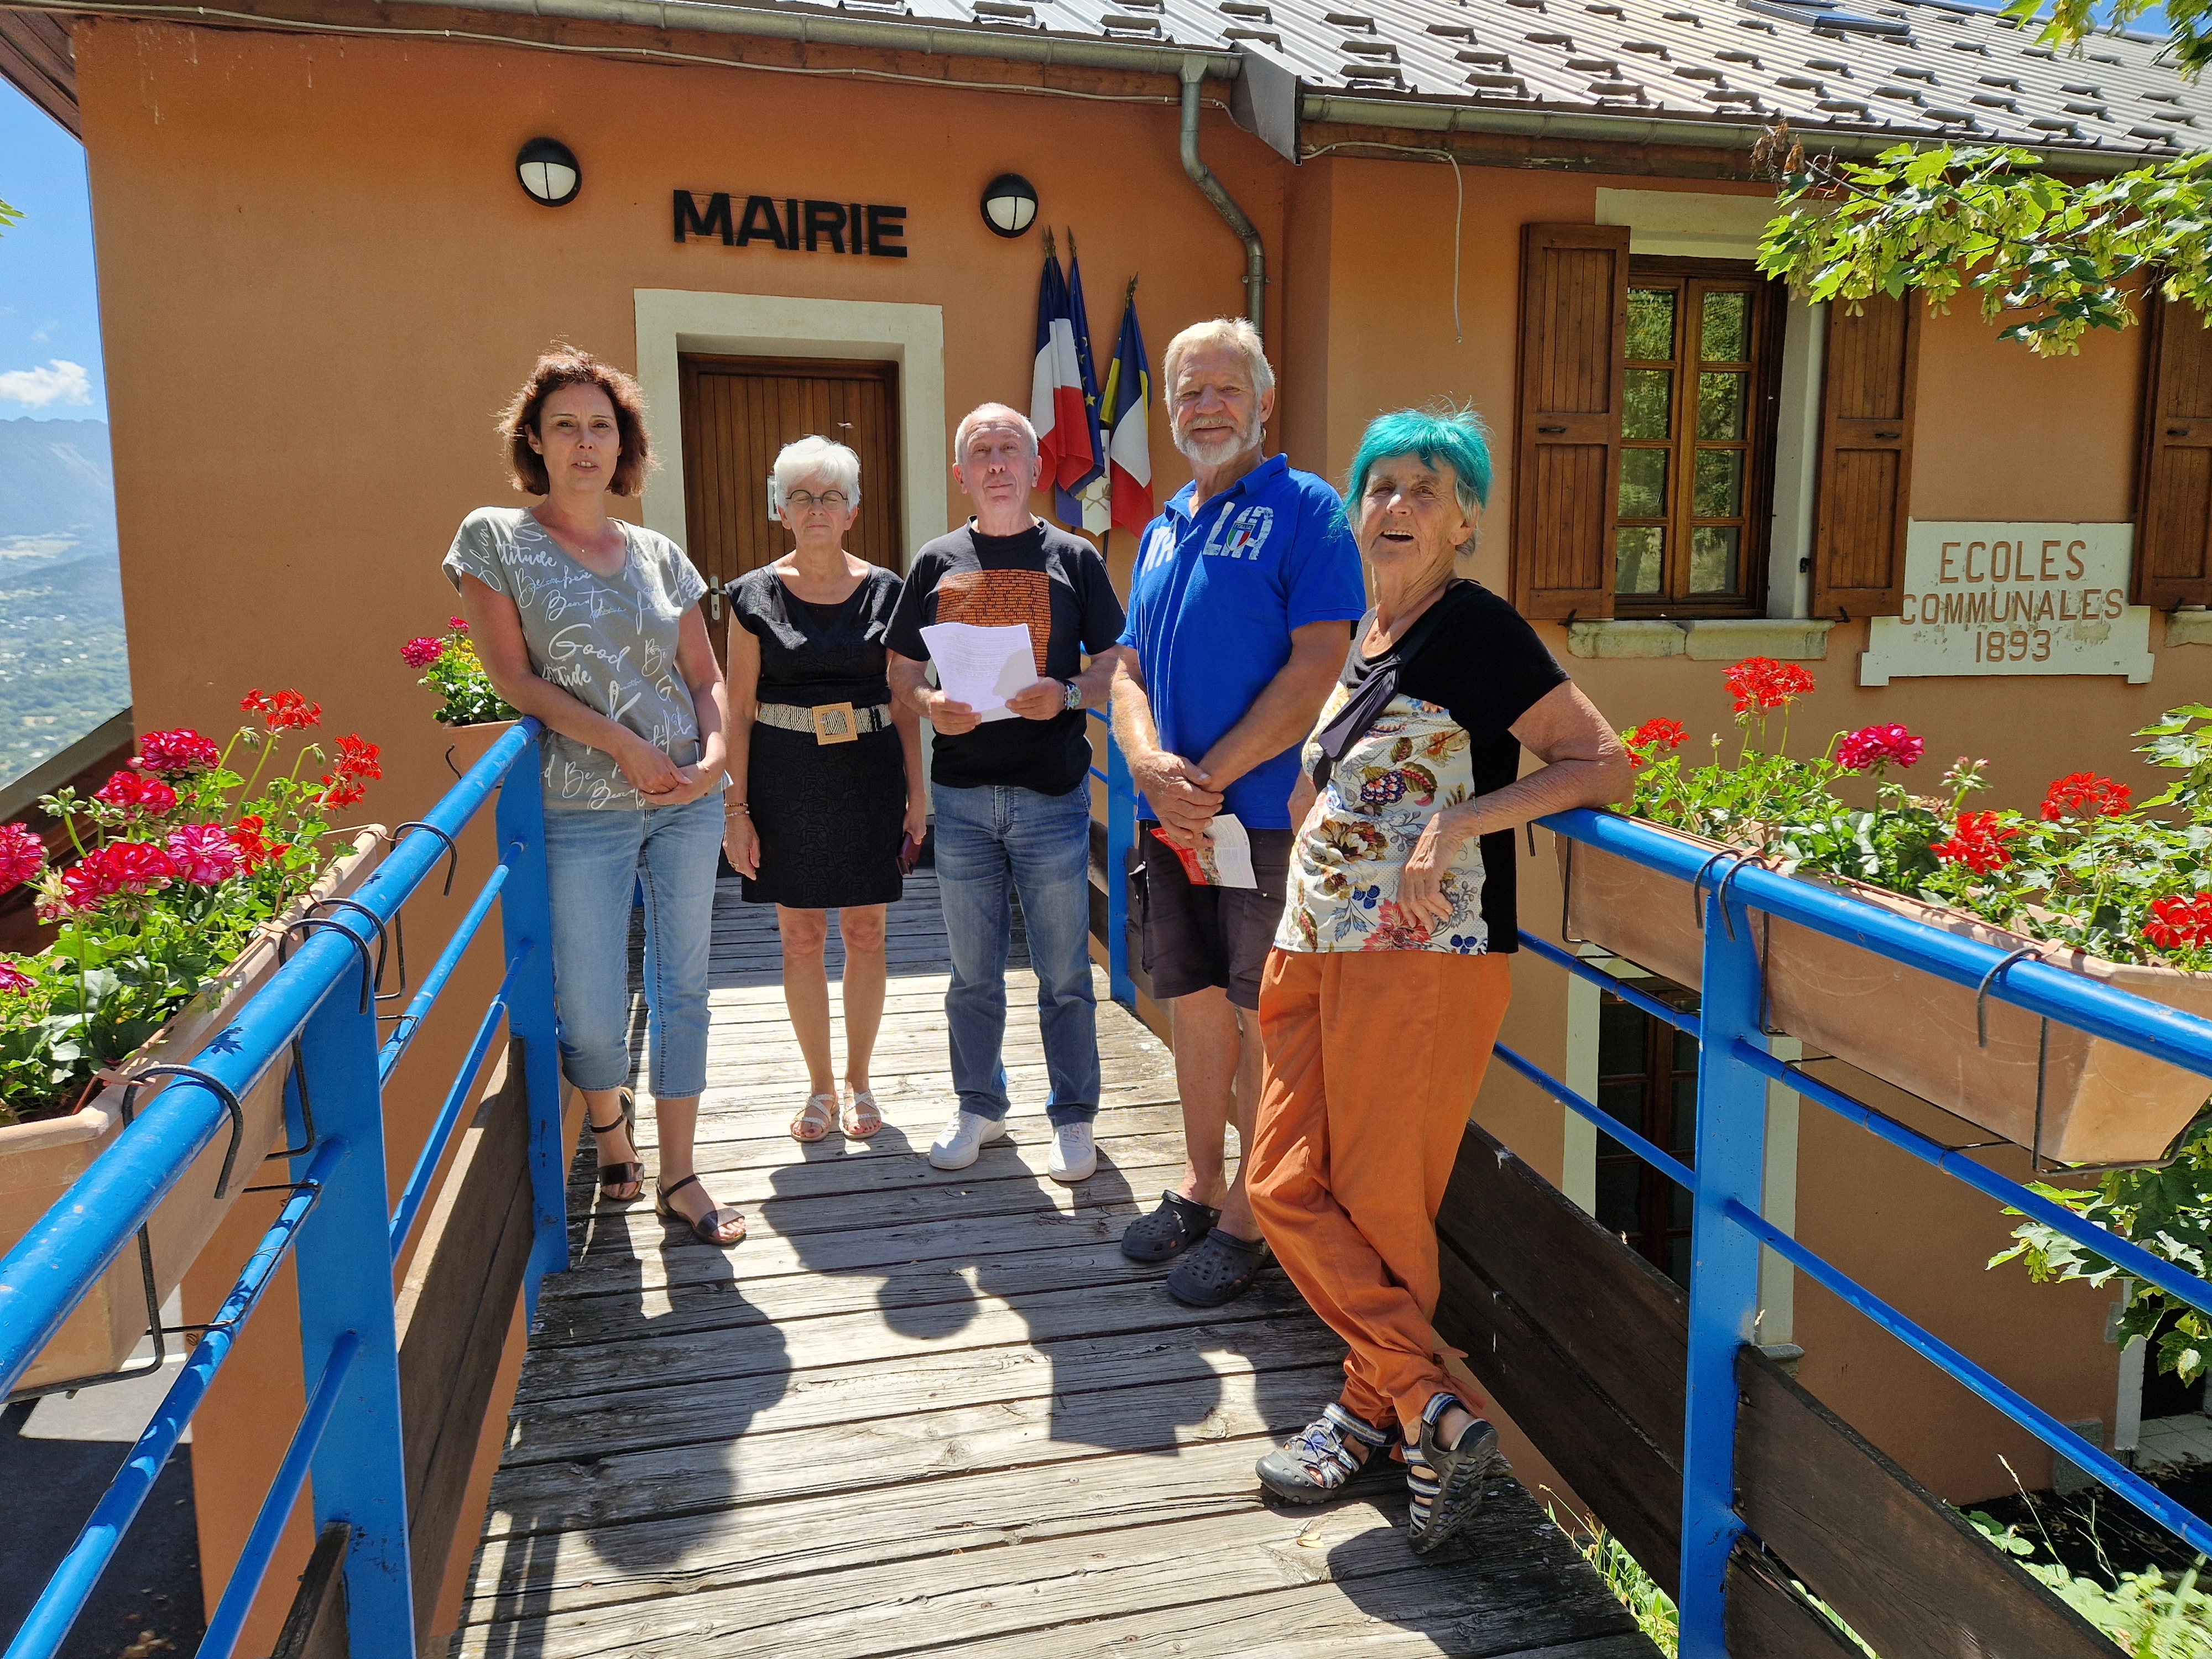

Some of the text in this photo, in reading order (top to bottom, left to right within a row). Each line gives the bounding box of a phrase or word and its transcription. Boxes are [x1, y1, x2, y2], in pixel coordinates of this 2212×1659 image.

[673, 189, 907, 258] MAIRIE
[1939, 540, 2086, 583] ECOLES
[1900, 588, 2124, 625] COMMUNALES
[548, 623, 630, 672] Good
[1976, 629, 2051, 662] 1893
